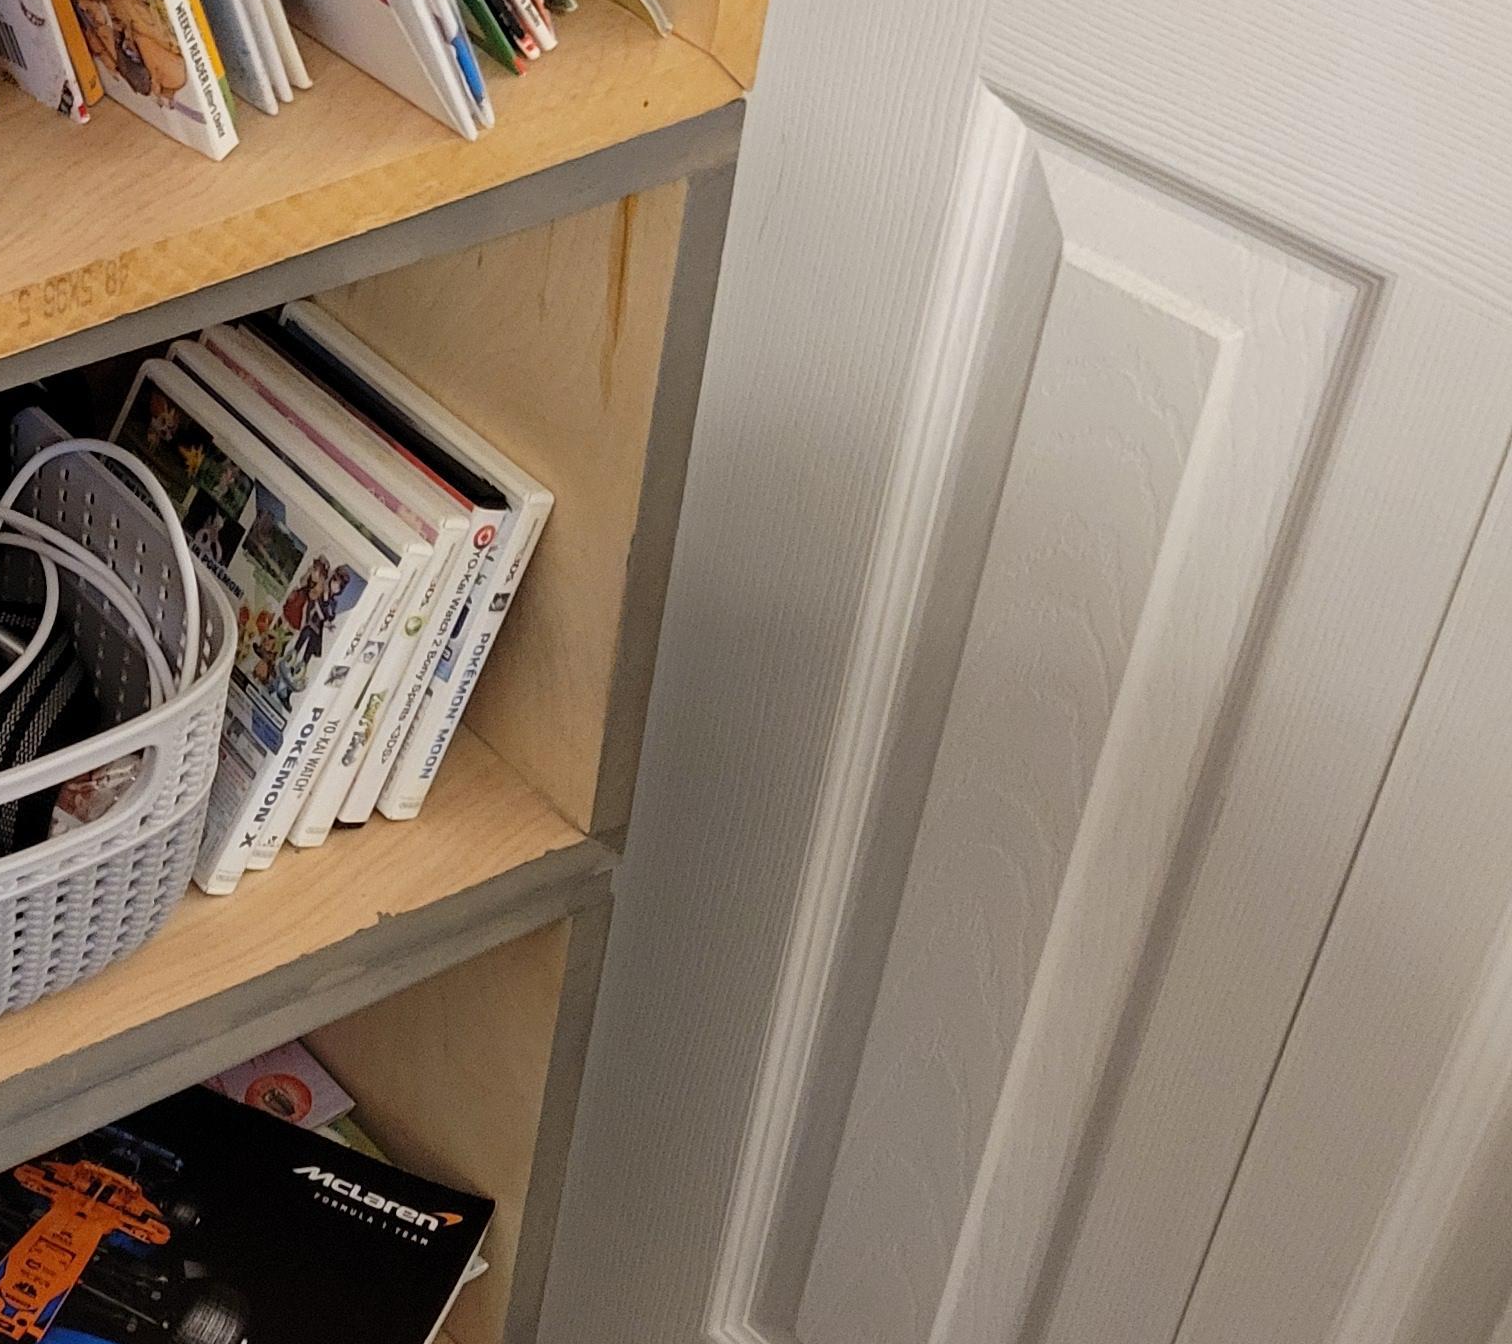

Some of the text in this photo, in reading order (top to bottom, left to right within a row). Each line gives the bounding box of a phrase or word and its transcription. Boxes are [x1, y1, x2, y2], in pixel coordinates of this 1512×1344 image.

[175, 1, 196, 44] WEEKLY
[189, 41, 211, 84] READER
[438, 595, 465, 638] Watch
[416, 646, 438, 683] Bony
[397, 682, 423, 723] Spirits
[417, 631, 492, 780] POKÉMON MOON
[252, 706, 326, 824] POKÉMON
[292, 719, 341, 793] YO-KAI WATCH
[239, 832, 258, 849] X
[292, 1166, 439, 1232] McLaren
[313, 1191, 374, 1225] FORMULA
[394, 1226, 430, 1247] TEAM
